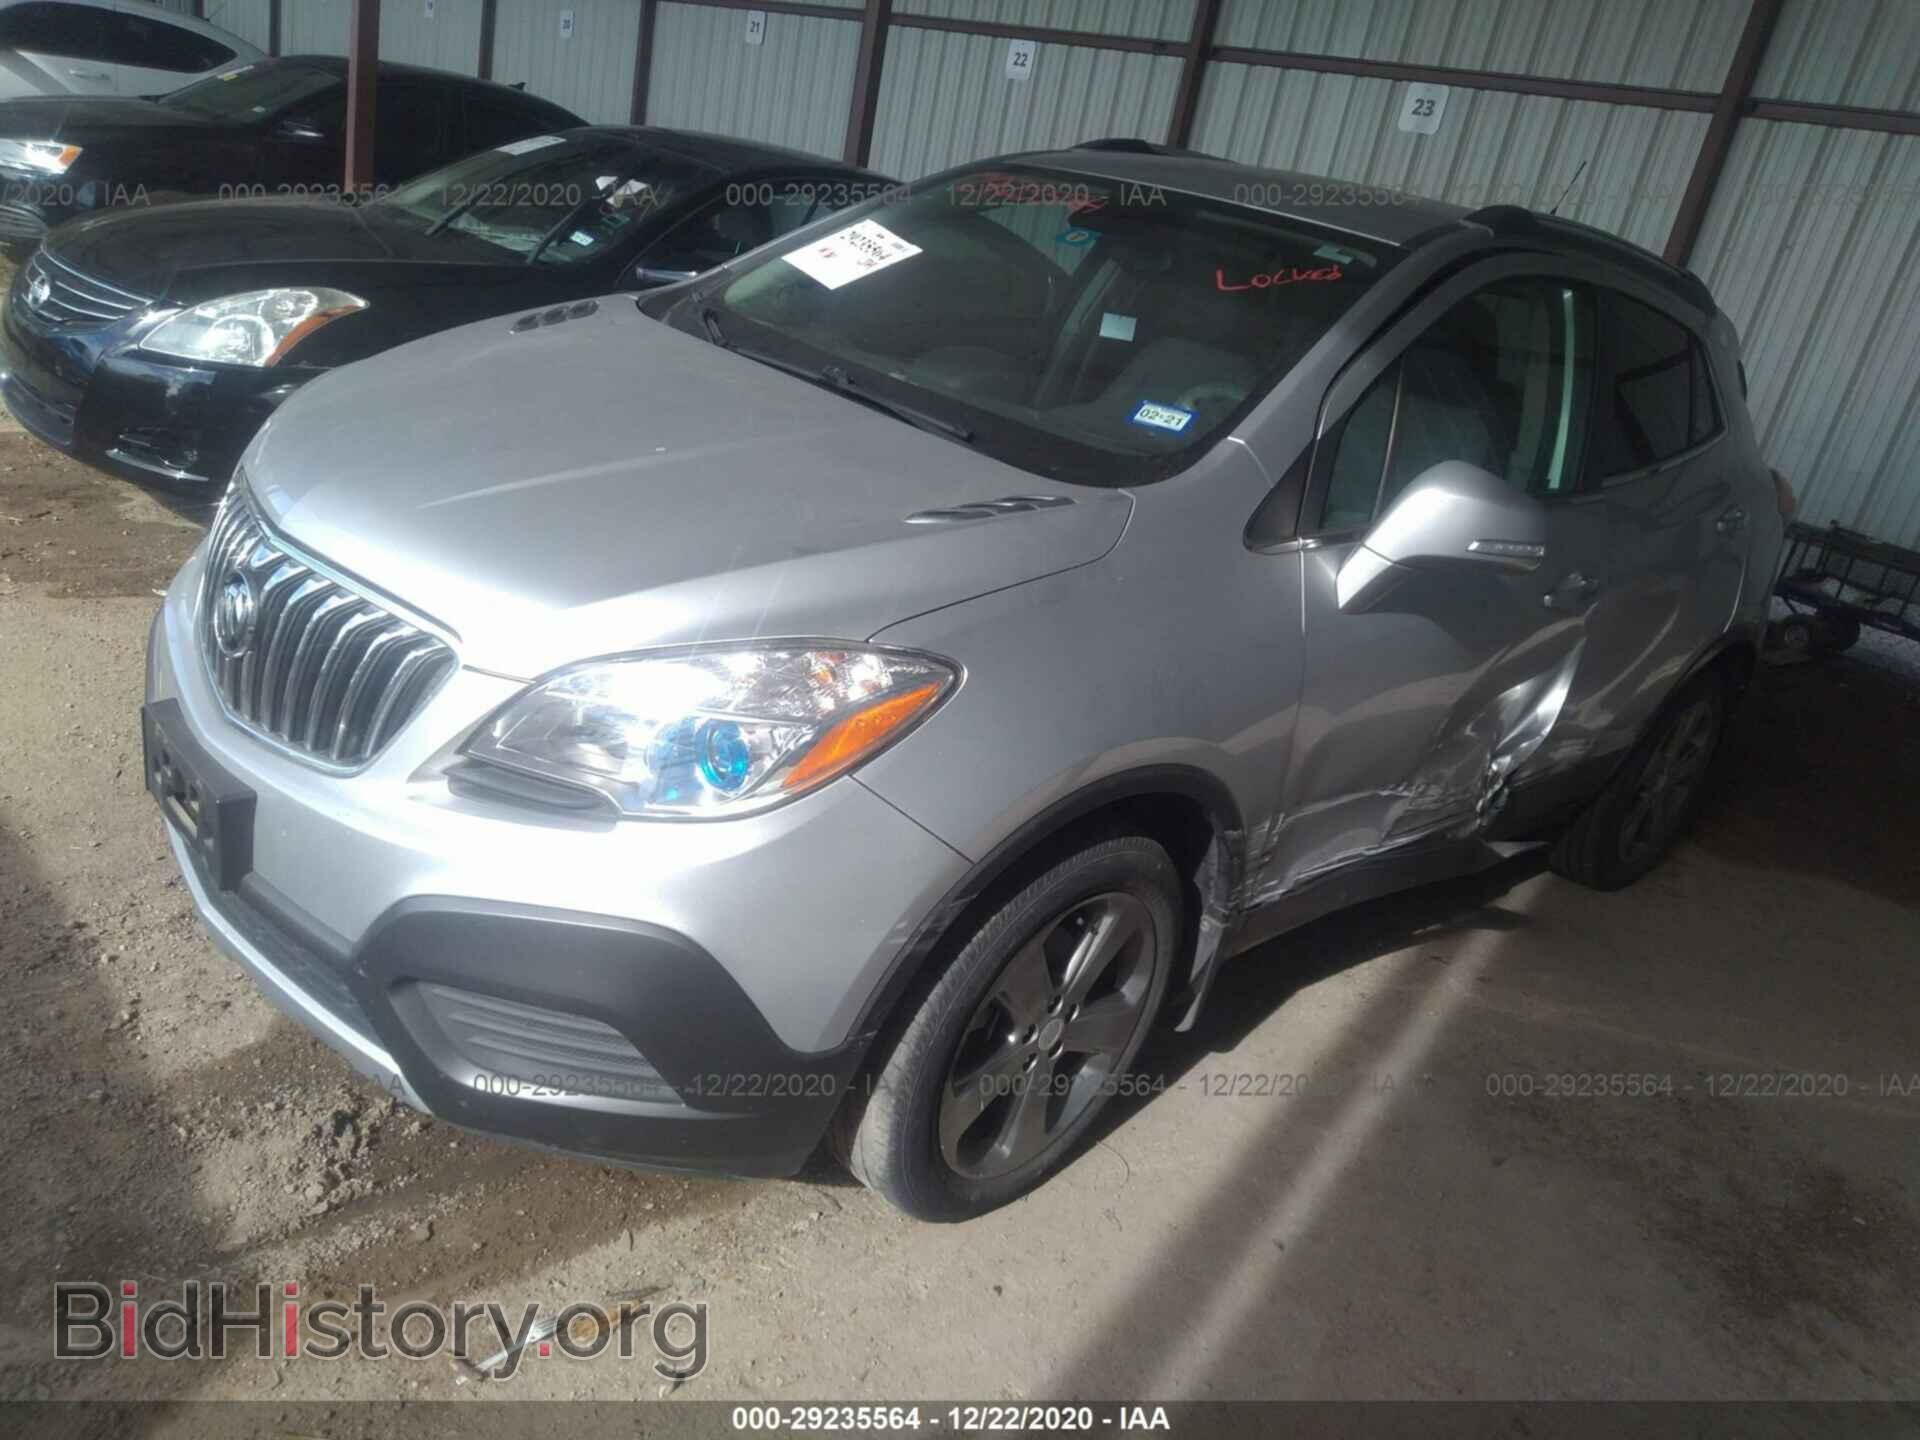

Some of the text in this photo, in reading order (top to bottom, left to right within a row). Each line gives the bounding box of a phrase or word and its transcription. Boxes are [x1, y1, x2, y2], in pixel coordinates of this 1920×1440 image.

[750, 20, 760, 32] 21
[1013, 52, 1028, 66] 22
[1412, 98, 1436, 117] 23
